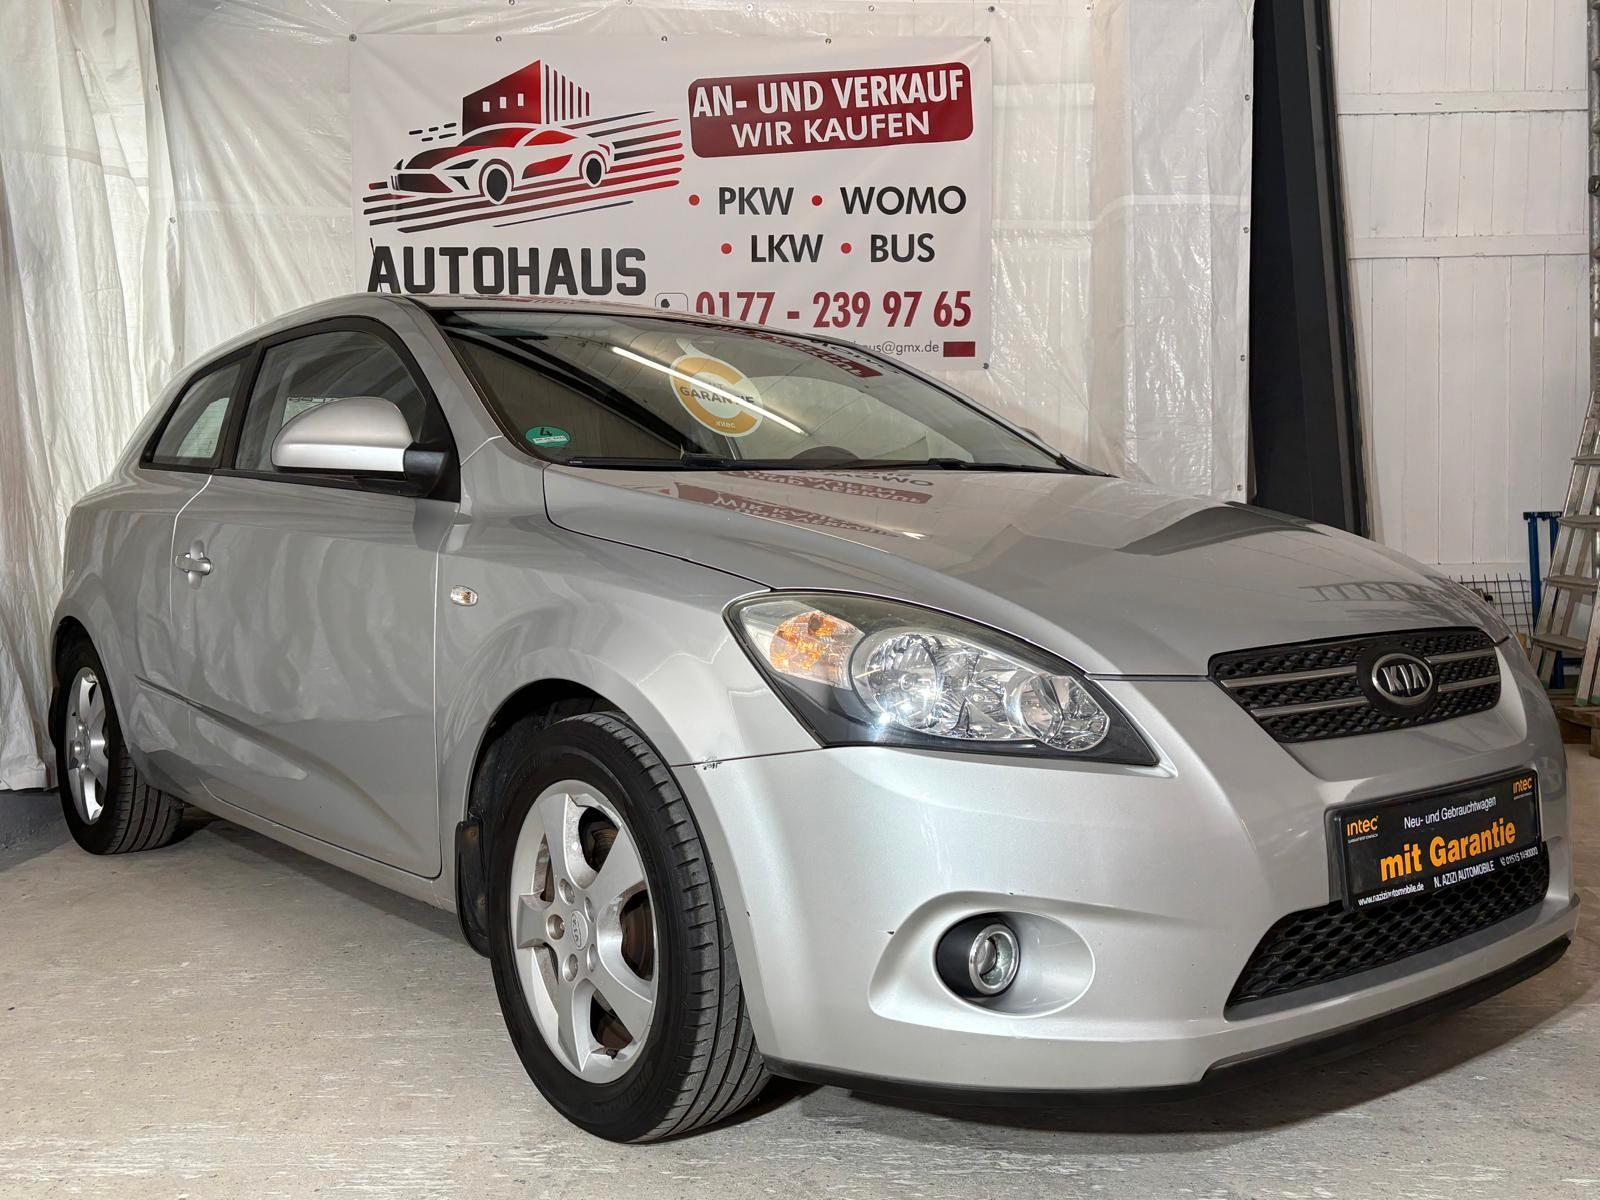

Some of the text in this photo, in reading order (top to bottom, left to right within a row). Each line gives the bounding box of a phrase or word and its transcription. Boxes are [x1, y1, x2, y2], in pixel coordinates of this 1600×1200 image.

[692, 69, 964, 118] AN- UND VERKAUF
[731, 110, 930, 148] WIR KAUFEN
[718, 185, 967, 215] PKW WOMO
[751, 232, 936, 263] LKW BUS
[367, 246, 647, 296] AUTOHAUS
[695, 291, 776, 326] 0177
[812, 291, 871, 328] 239
[882, 290, 923, 328] 97
[933, 290, 972, 328] 65
[1381, 663, 1427, 693] KIA
[1346, 817, 1378, 836] intec
[1404, 796, 1497, 830] Neu- und Gebrauchtwagen
[1380, 817, 1516, 882] mit Garantie
[1442, 871, 1458, 887] AZIZI
[1458, 860, 1495, 882] AUTOMOBILE
